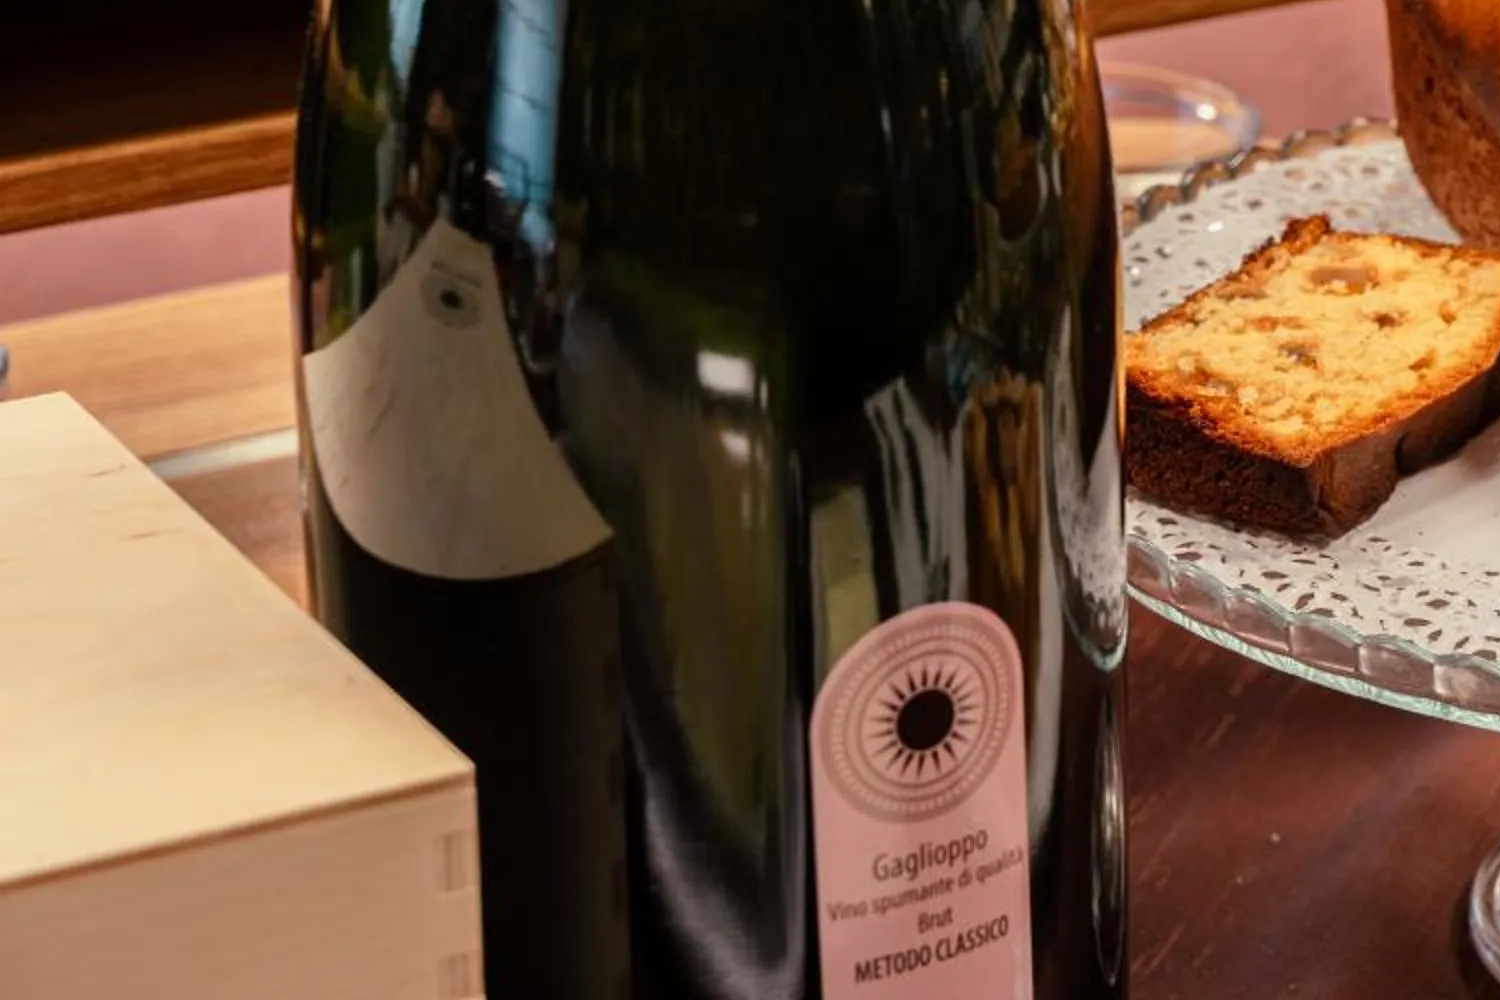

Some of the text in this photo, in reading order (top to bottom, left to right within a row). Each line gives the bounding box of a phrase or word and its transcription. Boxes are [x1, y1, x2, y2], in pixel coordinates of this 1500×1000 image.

[872, 829, 989, 882] Gaglioppo
[828, 899, 868, 922] Vino
[872, 875, 954, 917] spumante
[958, 867, 973, 888] di
[917, 906, 954, 935] Brut
[854, 914, 1009, 984] METODO CLASSICO
